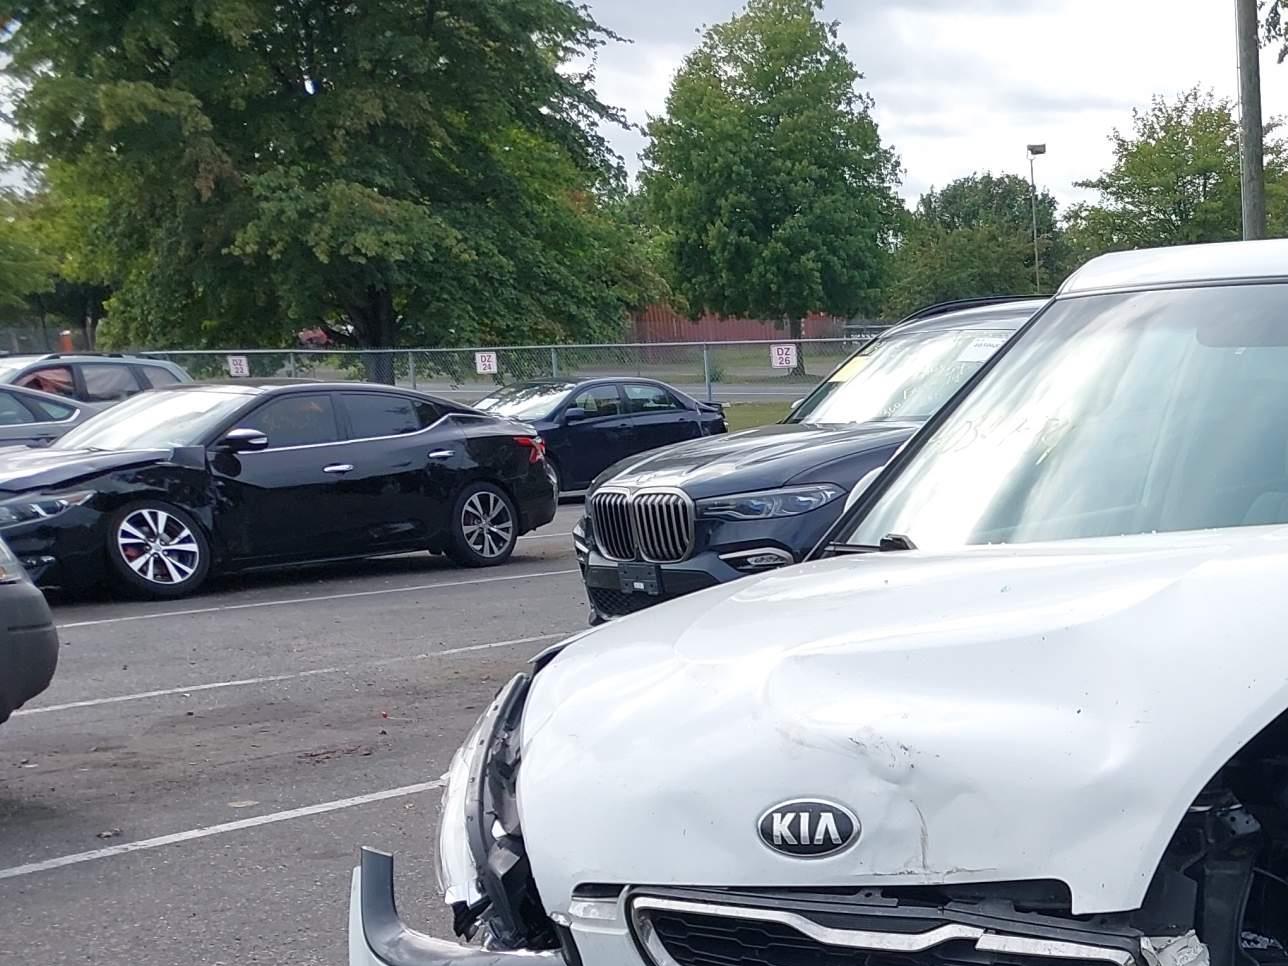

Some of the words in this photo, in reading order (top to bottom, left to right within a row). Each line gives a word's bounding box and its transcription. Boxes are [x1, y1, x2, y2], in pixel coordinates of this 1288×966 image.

[776, 347, 791, 356] DZ
[480, 354, 492, 363] DZ
[778, 356, 791, 365] 26
[772, 812, 842, 845] KIA
